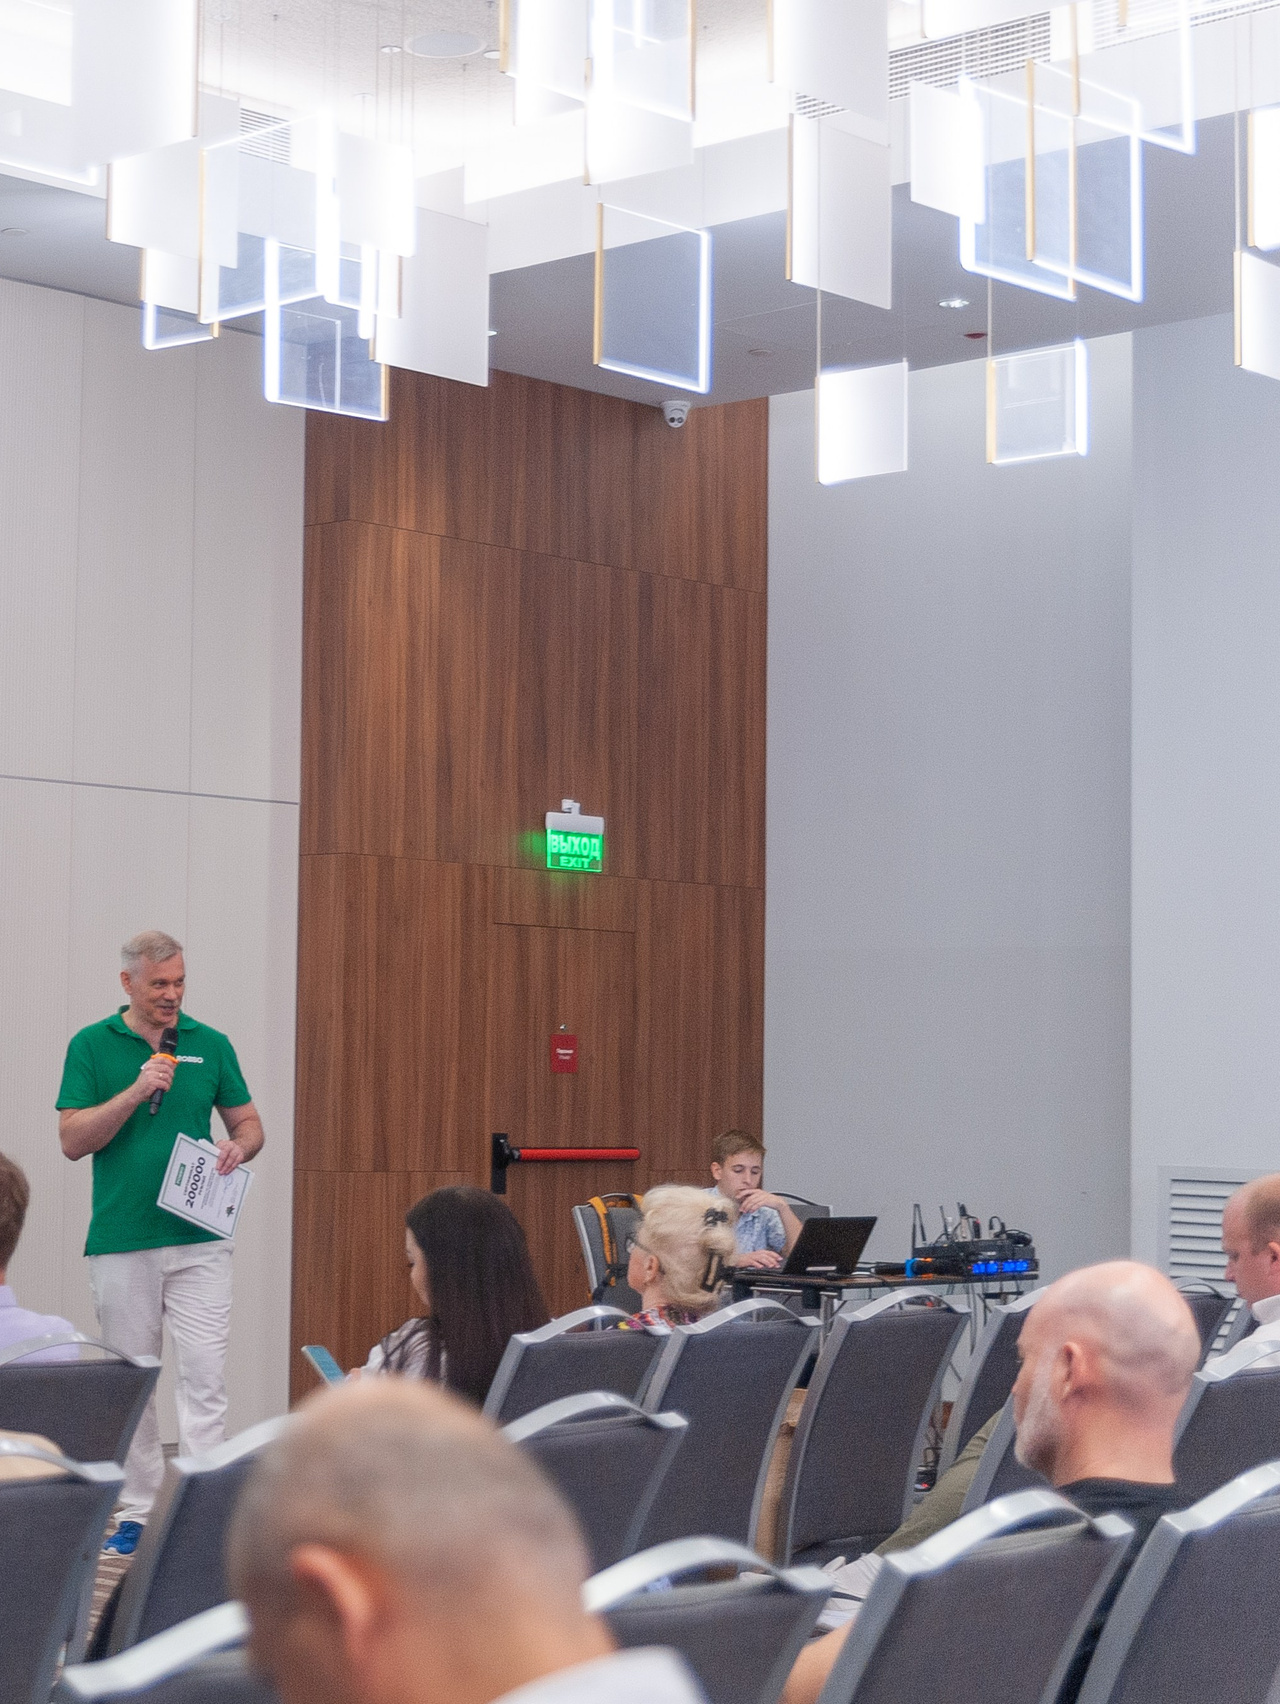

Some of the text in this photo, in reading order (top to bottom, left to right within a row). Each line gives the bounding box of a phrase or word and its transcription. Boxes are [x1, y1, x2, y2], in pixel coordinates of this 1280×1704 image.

[551, 834, 600, 860] ВЫХОД
[560, 856, 590, 868] EXIT
[185, 1157, 206, 1208] 200000
